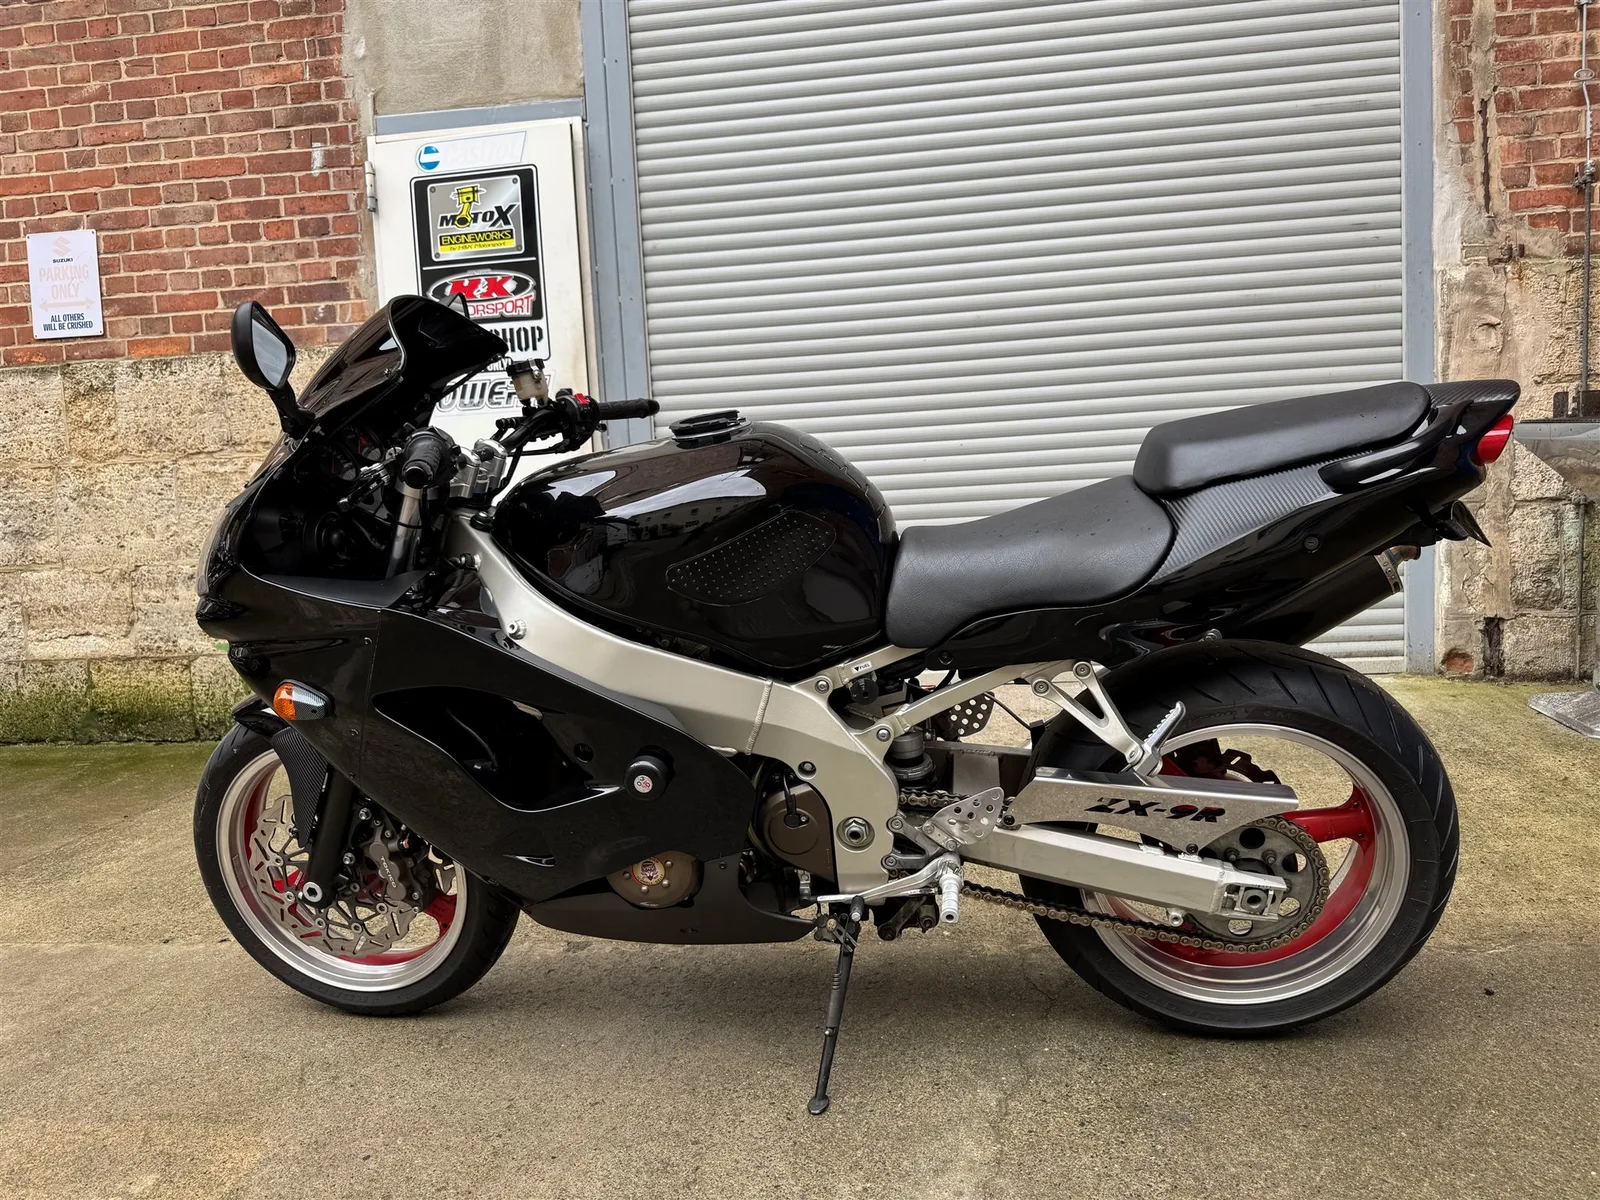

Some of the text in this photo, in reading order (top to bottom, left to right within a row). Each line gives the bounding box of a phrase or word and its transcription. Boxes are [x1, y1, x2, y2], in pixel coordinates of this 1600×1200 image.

[441, 230, 512, 245] ENGINEWORKS
[39, 264, 89, 282] PARKING
[51, 283, 80, 300] ONLY
[449, 275, 514, 299] H&K
[467, 294, 533, 316] ORSPORT
[43, 321, 93, 332] WILL BE CRUSHED
[50, 313, 85, 322] ALL OTHERS
[489, 325, 543, 353] HOP
[1084, 796, 1226, 823] ZX-9R
[381, 856, 397, 887] TOKICO
